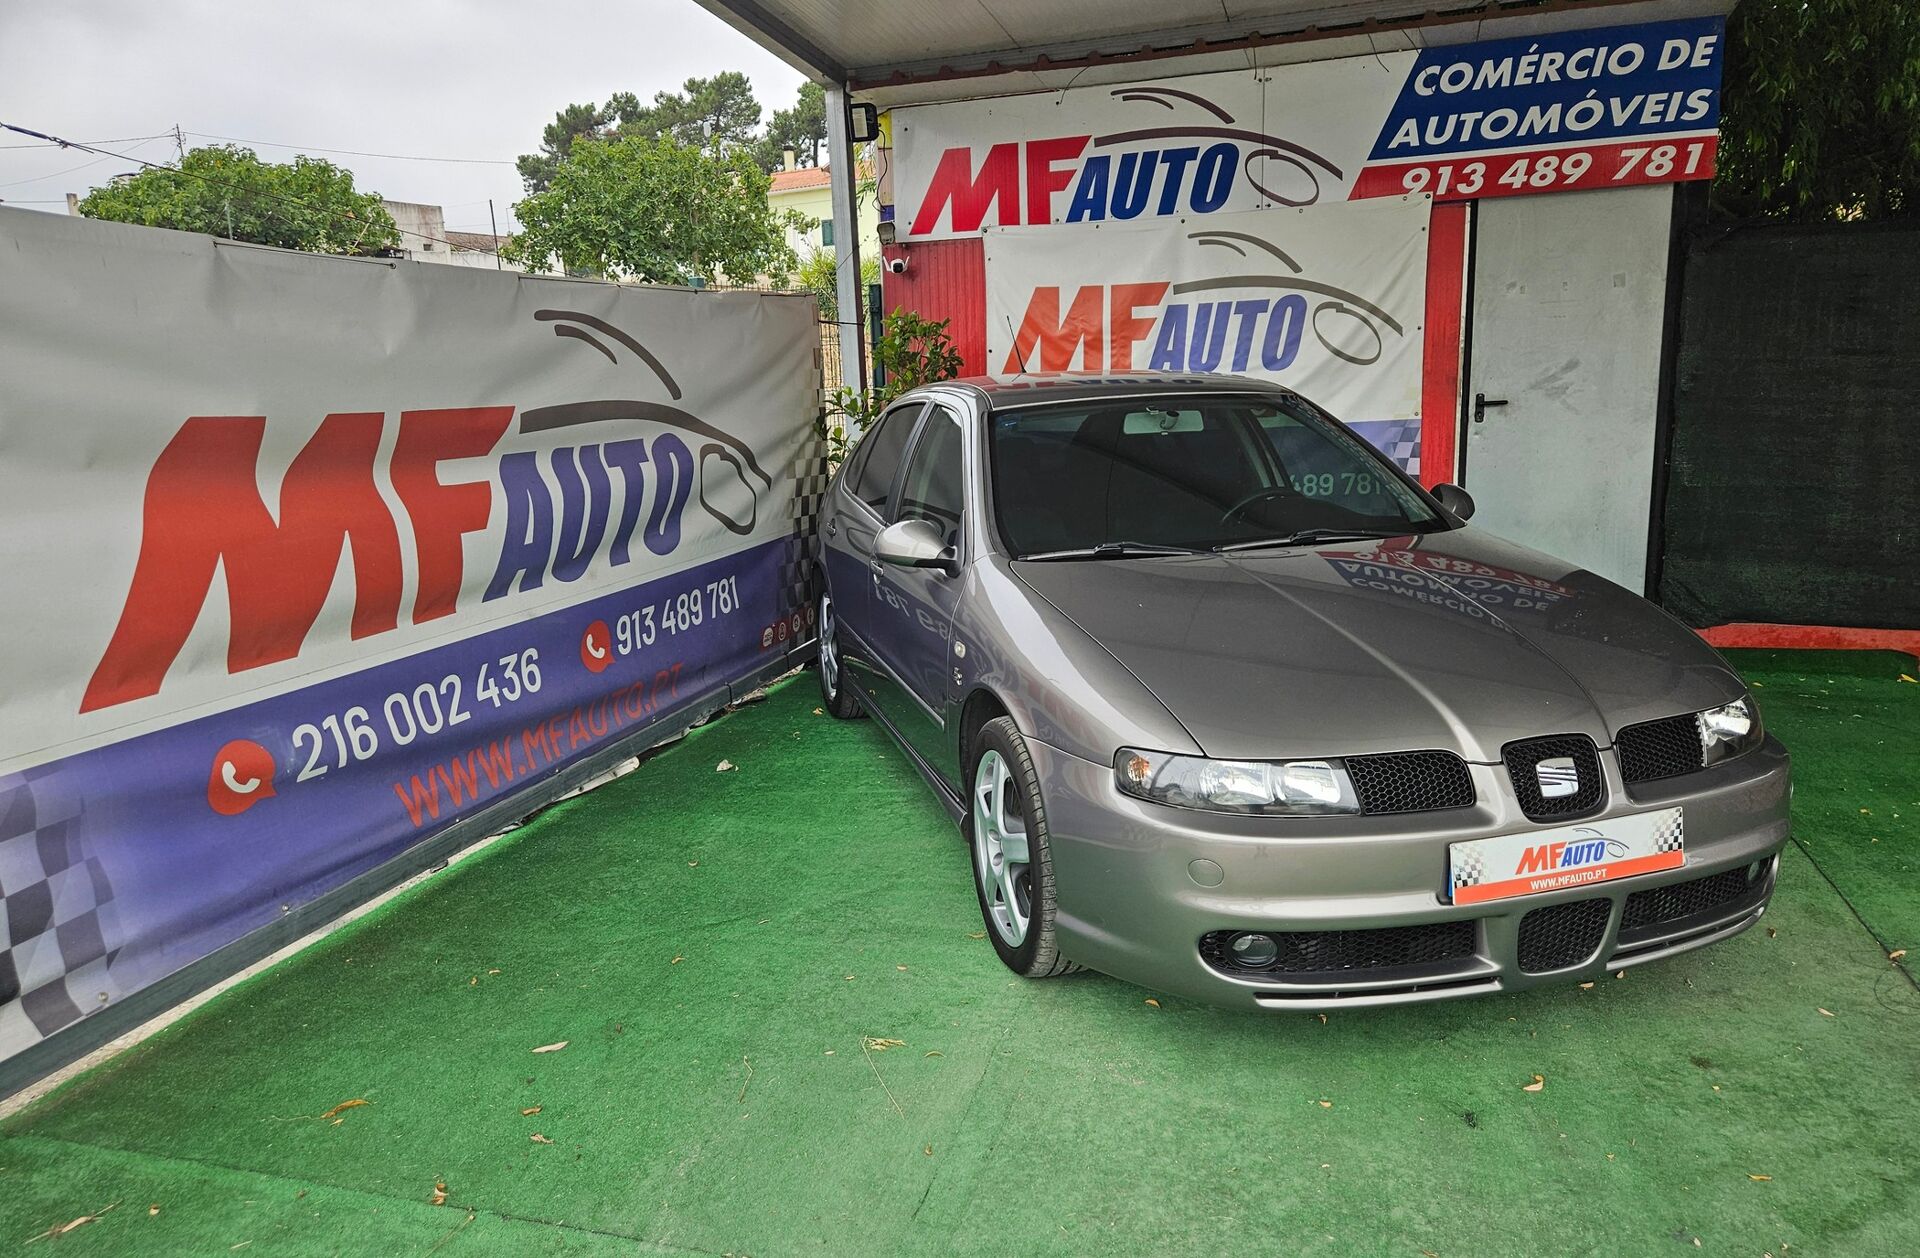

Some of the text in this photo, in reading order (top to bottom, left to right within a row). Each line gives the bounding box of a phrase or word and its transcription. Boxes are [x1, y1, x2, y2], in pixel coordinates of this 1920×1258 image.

[1414, 35, 1718, 96] COMÉRCIO DE
[1387, 88, 1714, 149] AUTOMÓVEIS
[1401, 143, 1705, 196] 913 489 781
[616, 575, 740, 655] 913 489 781
[292, 648, 541, 782] 216 002 436
[394, 661, 684, 829] WWW.MFAUTO.PT
[1530, 868, 1608, 890] WWW.MFAUTO.PT
